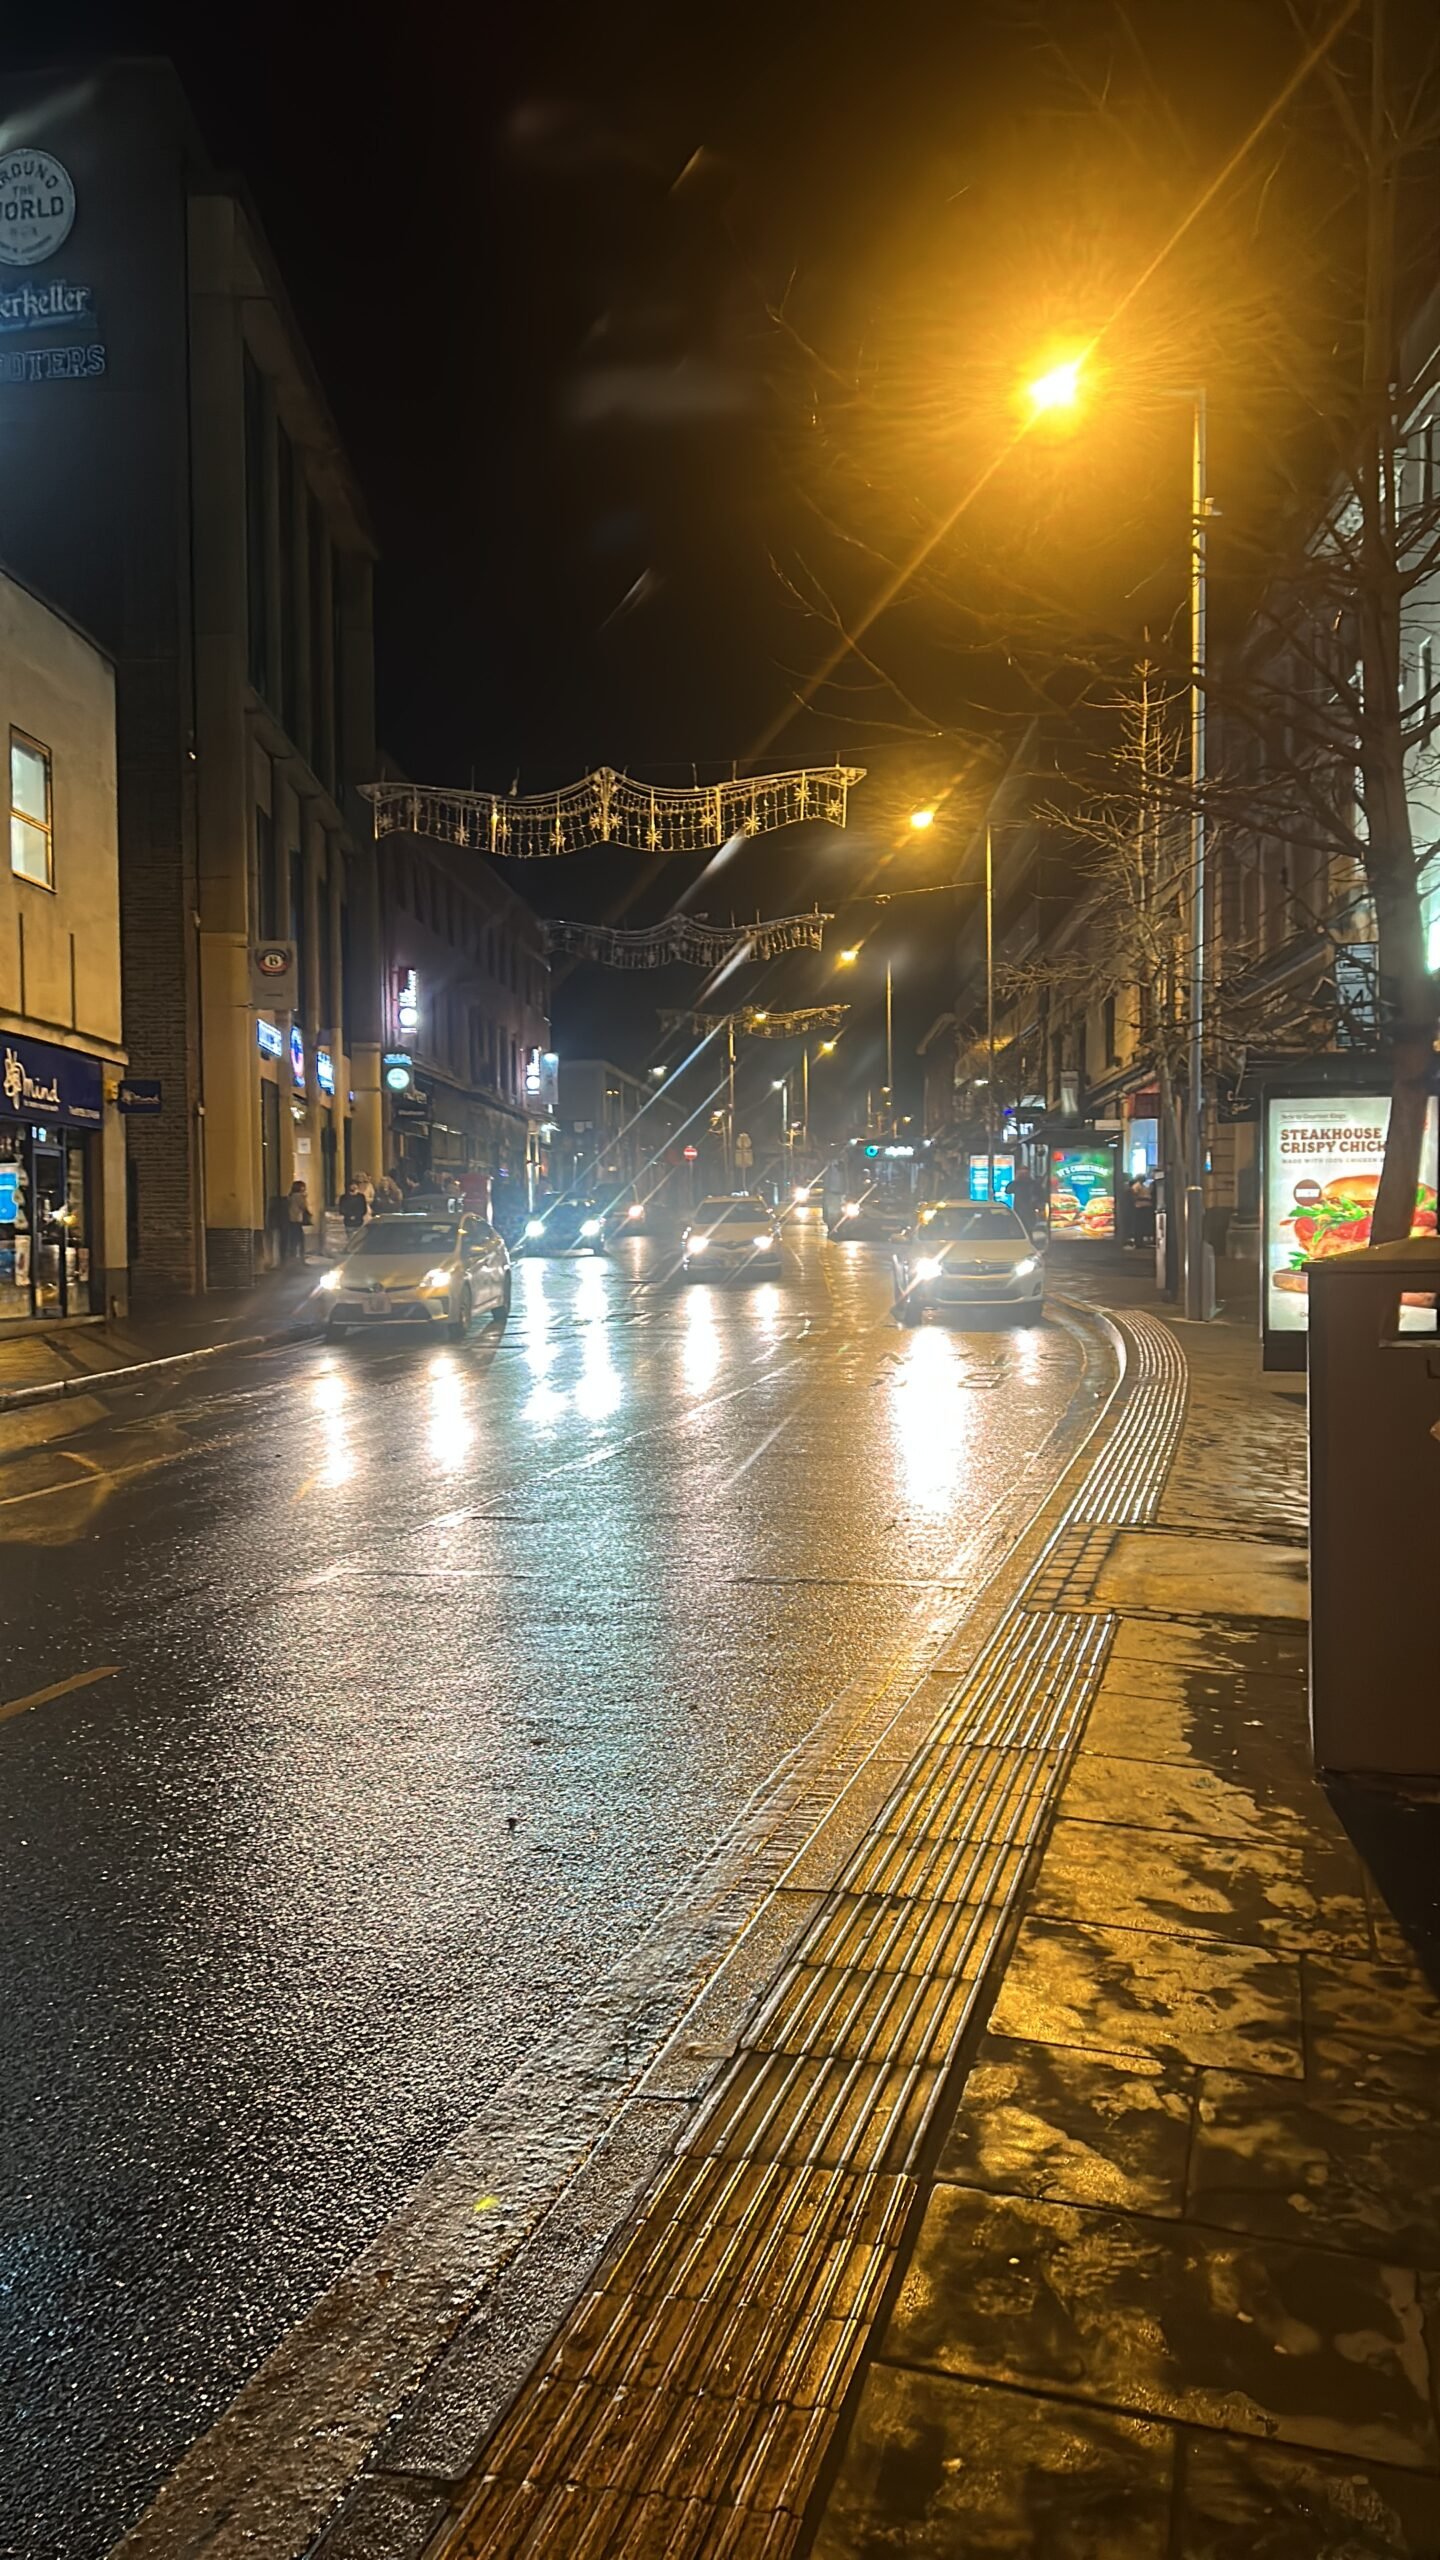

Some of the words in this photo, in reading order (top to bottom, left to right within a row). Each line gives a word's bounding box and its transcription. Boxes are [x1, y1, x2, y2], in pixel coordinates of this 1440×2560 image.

[23, 1077, 61, 1103] mind
[1281, 1128, 1382, 1140] STEAKHOUSE
[1281, 1141, 1336, 1153] CRISPY
